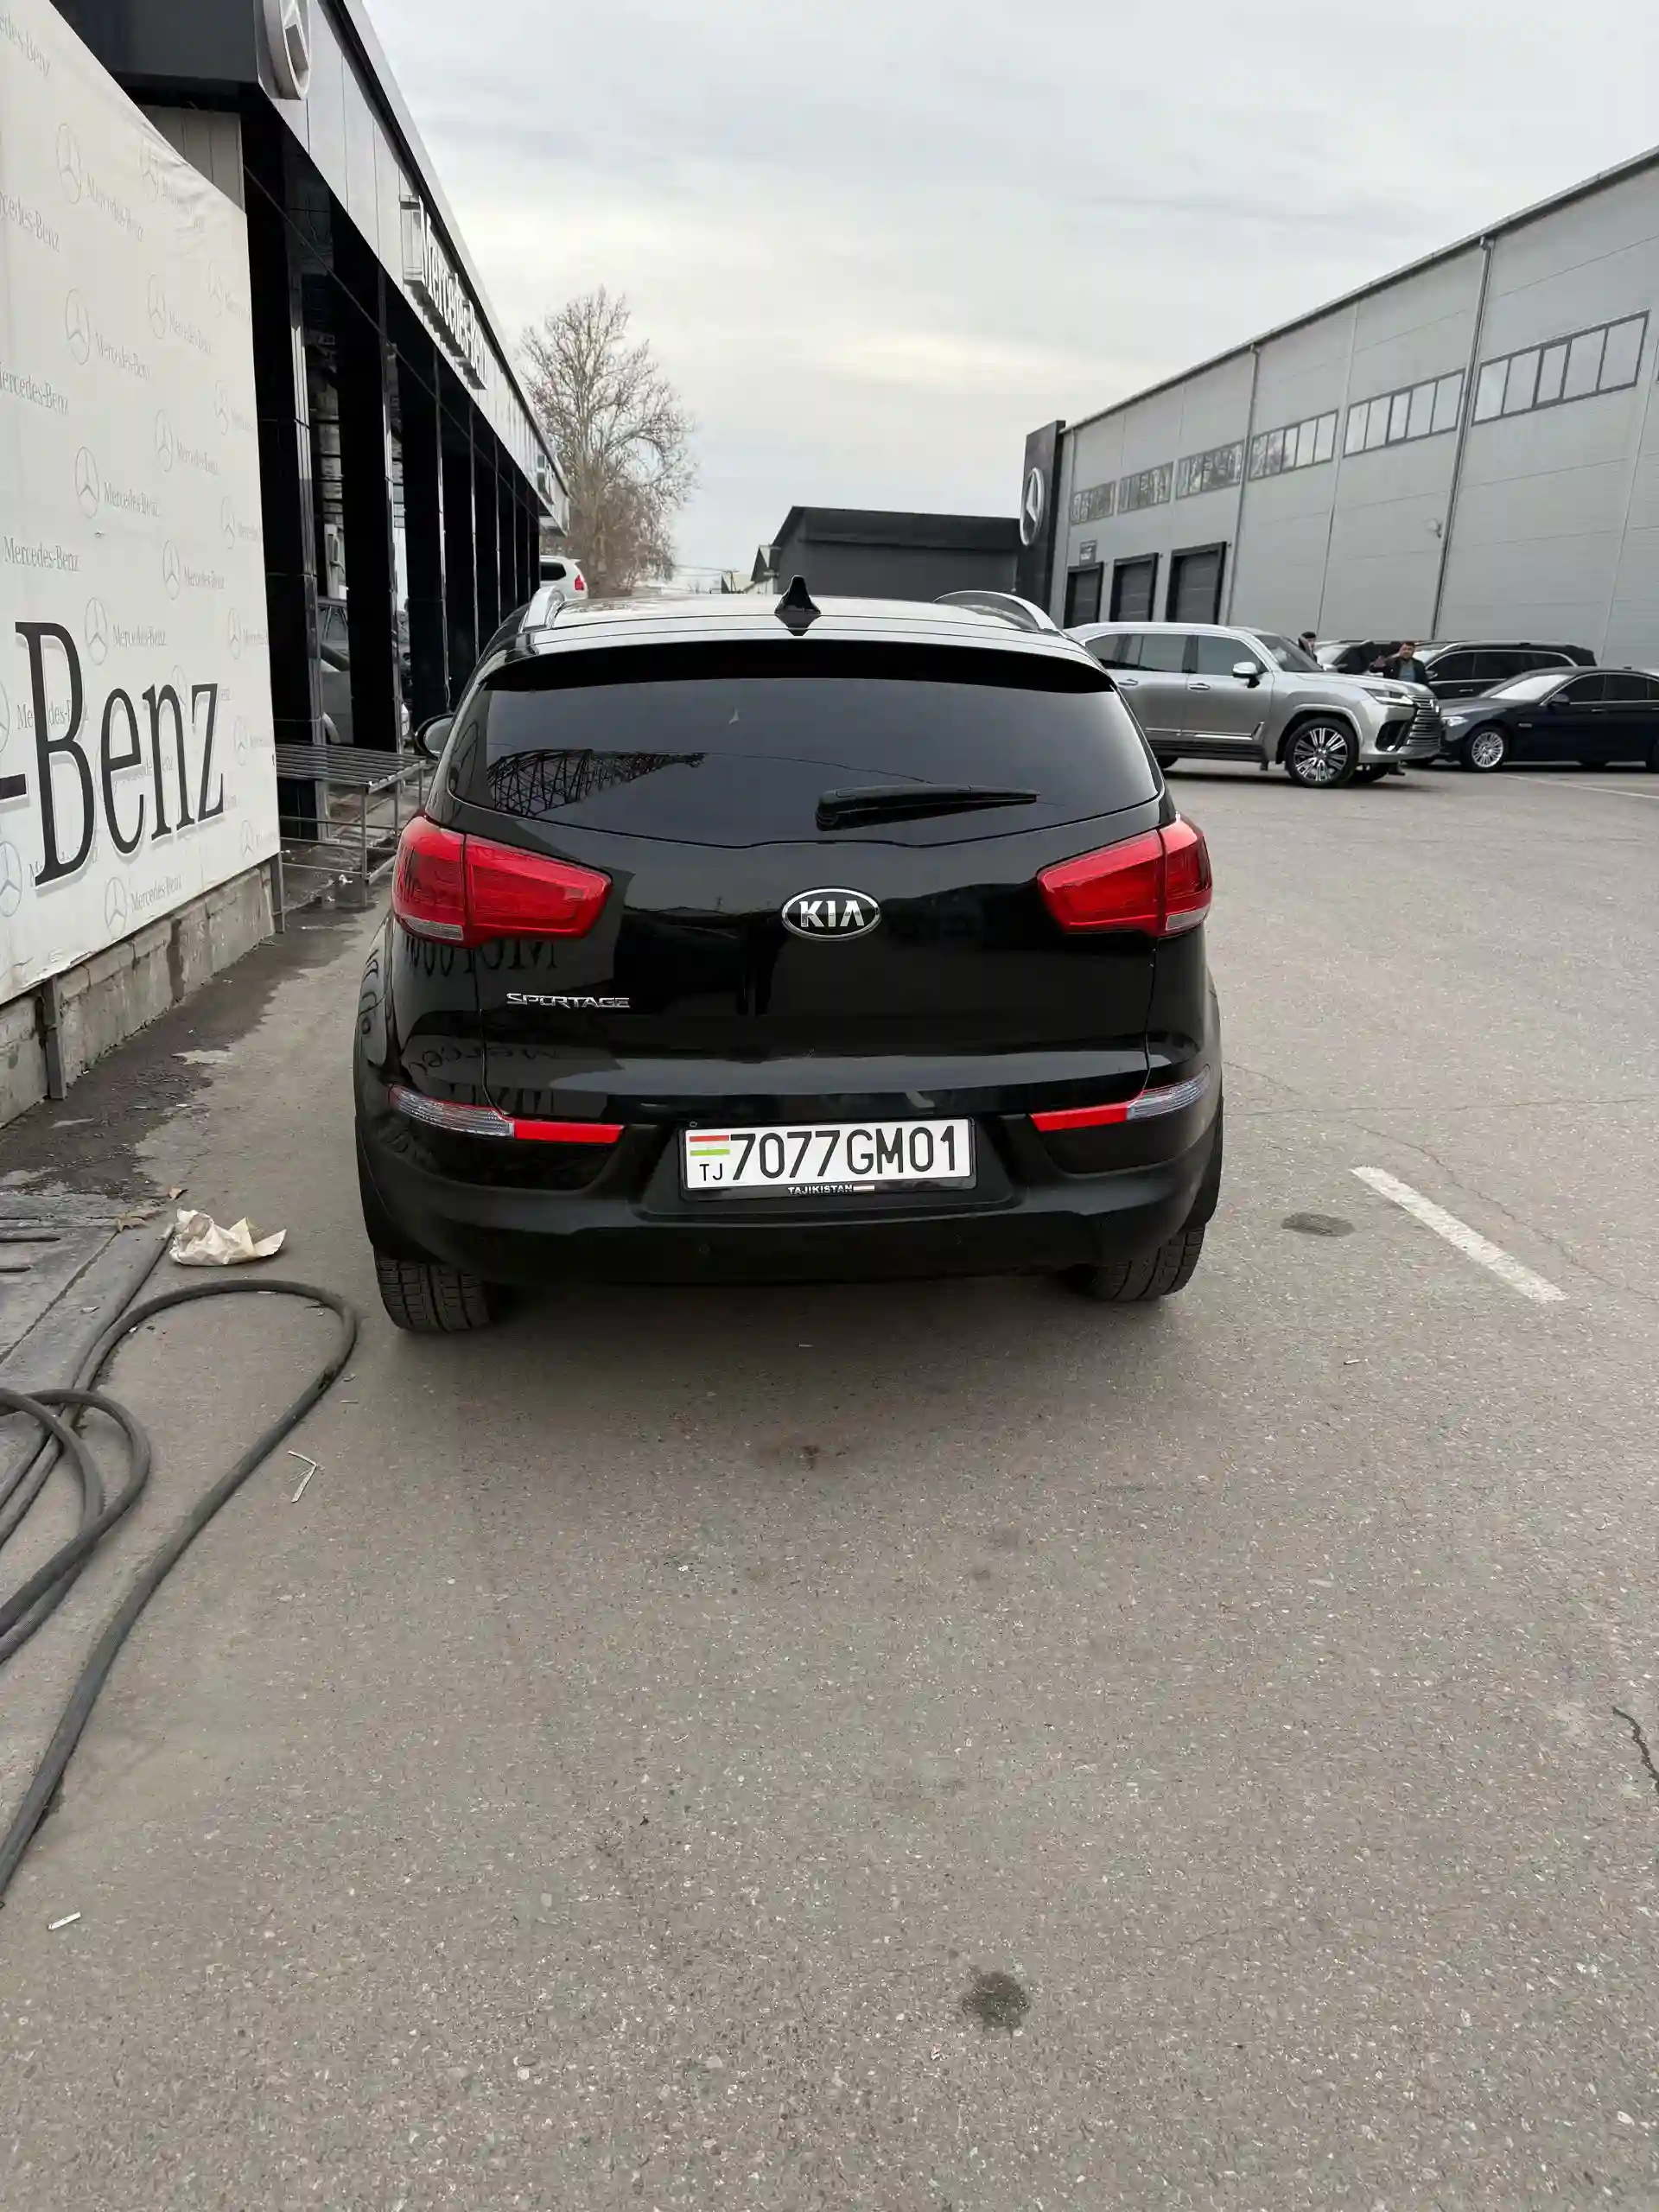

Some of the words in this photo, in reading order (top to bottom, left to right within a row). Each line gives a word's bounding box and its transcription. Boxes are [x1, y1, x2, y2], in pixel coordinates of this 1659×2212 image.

[3, 536, 80, 572] Mercedes-Benz
[799, 899, 865, 928] KIA
[505, 992, 631, 1009] SPORTAGE
[699, 1162, 723, 1182] TJ
[787, 1184, 853, 1195] TAJIKISTAN
